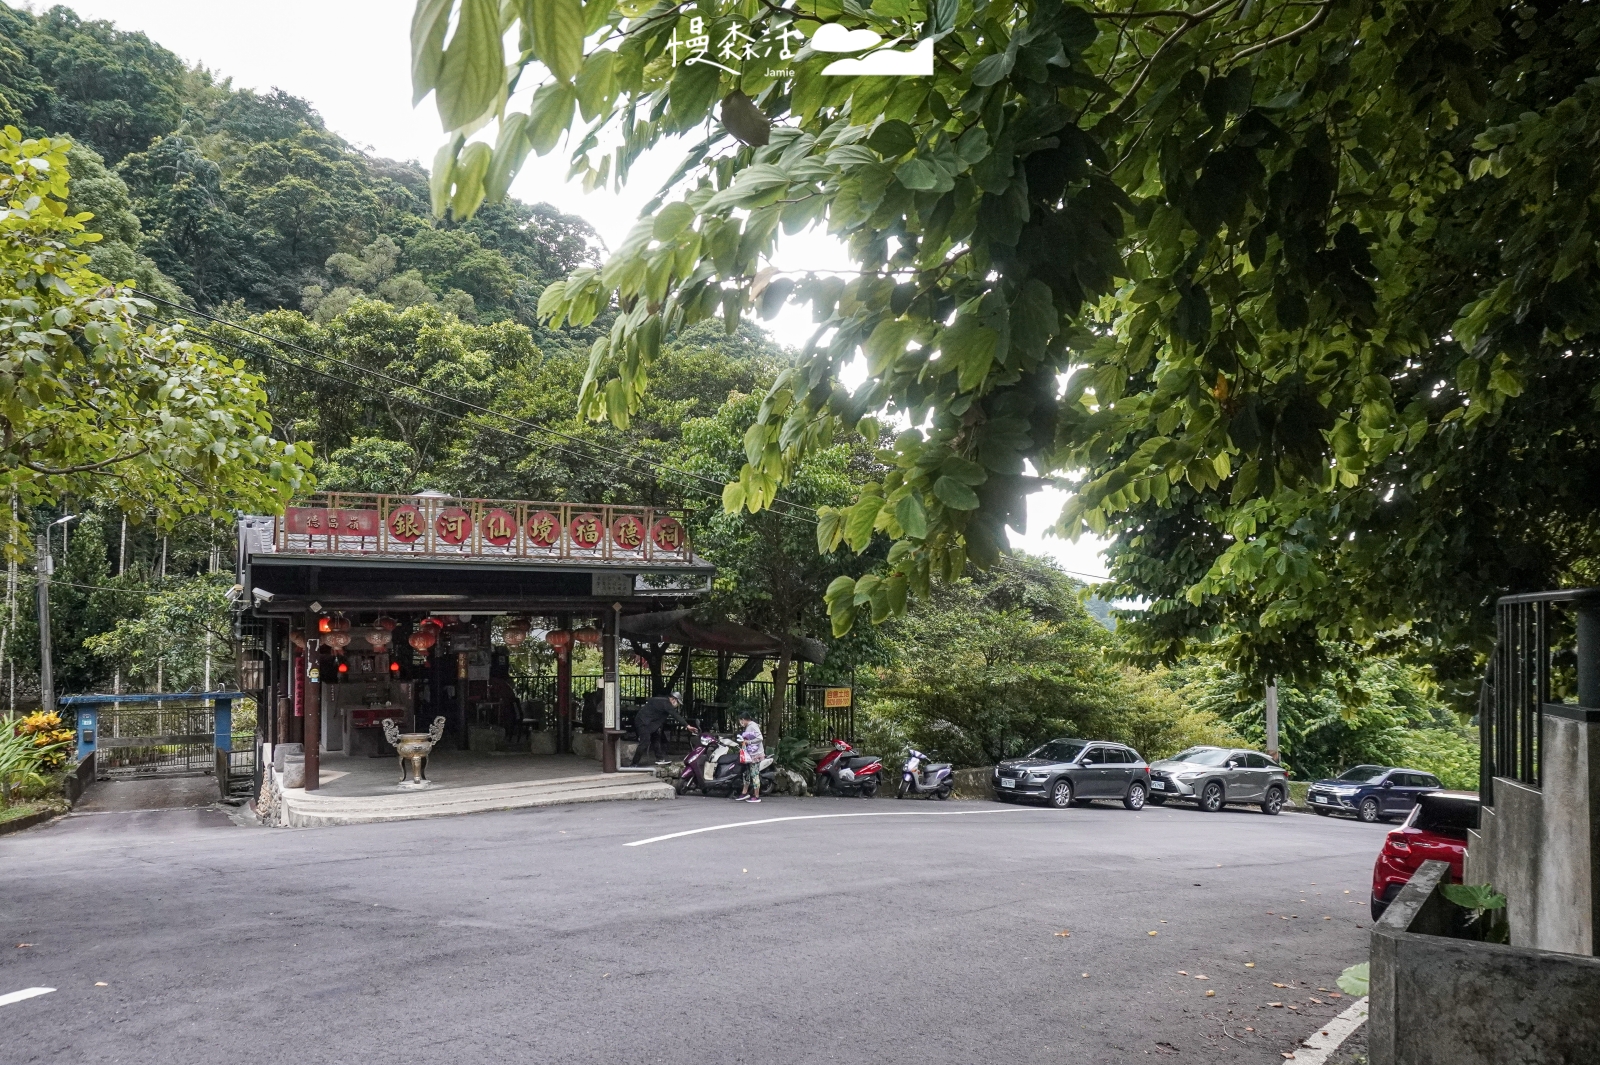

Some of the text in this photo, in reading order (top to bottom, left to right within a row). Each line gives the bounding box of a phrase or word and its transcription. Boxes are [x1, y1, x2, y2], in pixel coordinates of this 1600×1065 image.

[392, 510, 681, 548] 銀河仙境福德祠
